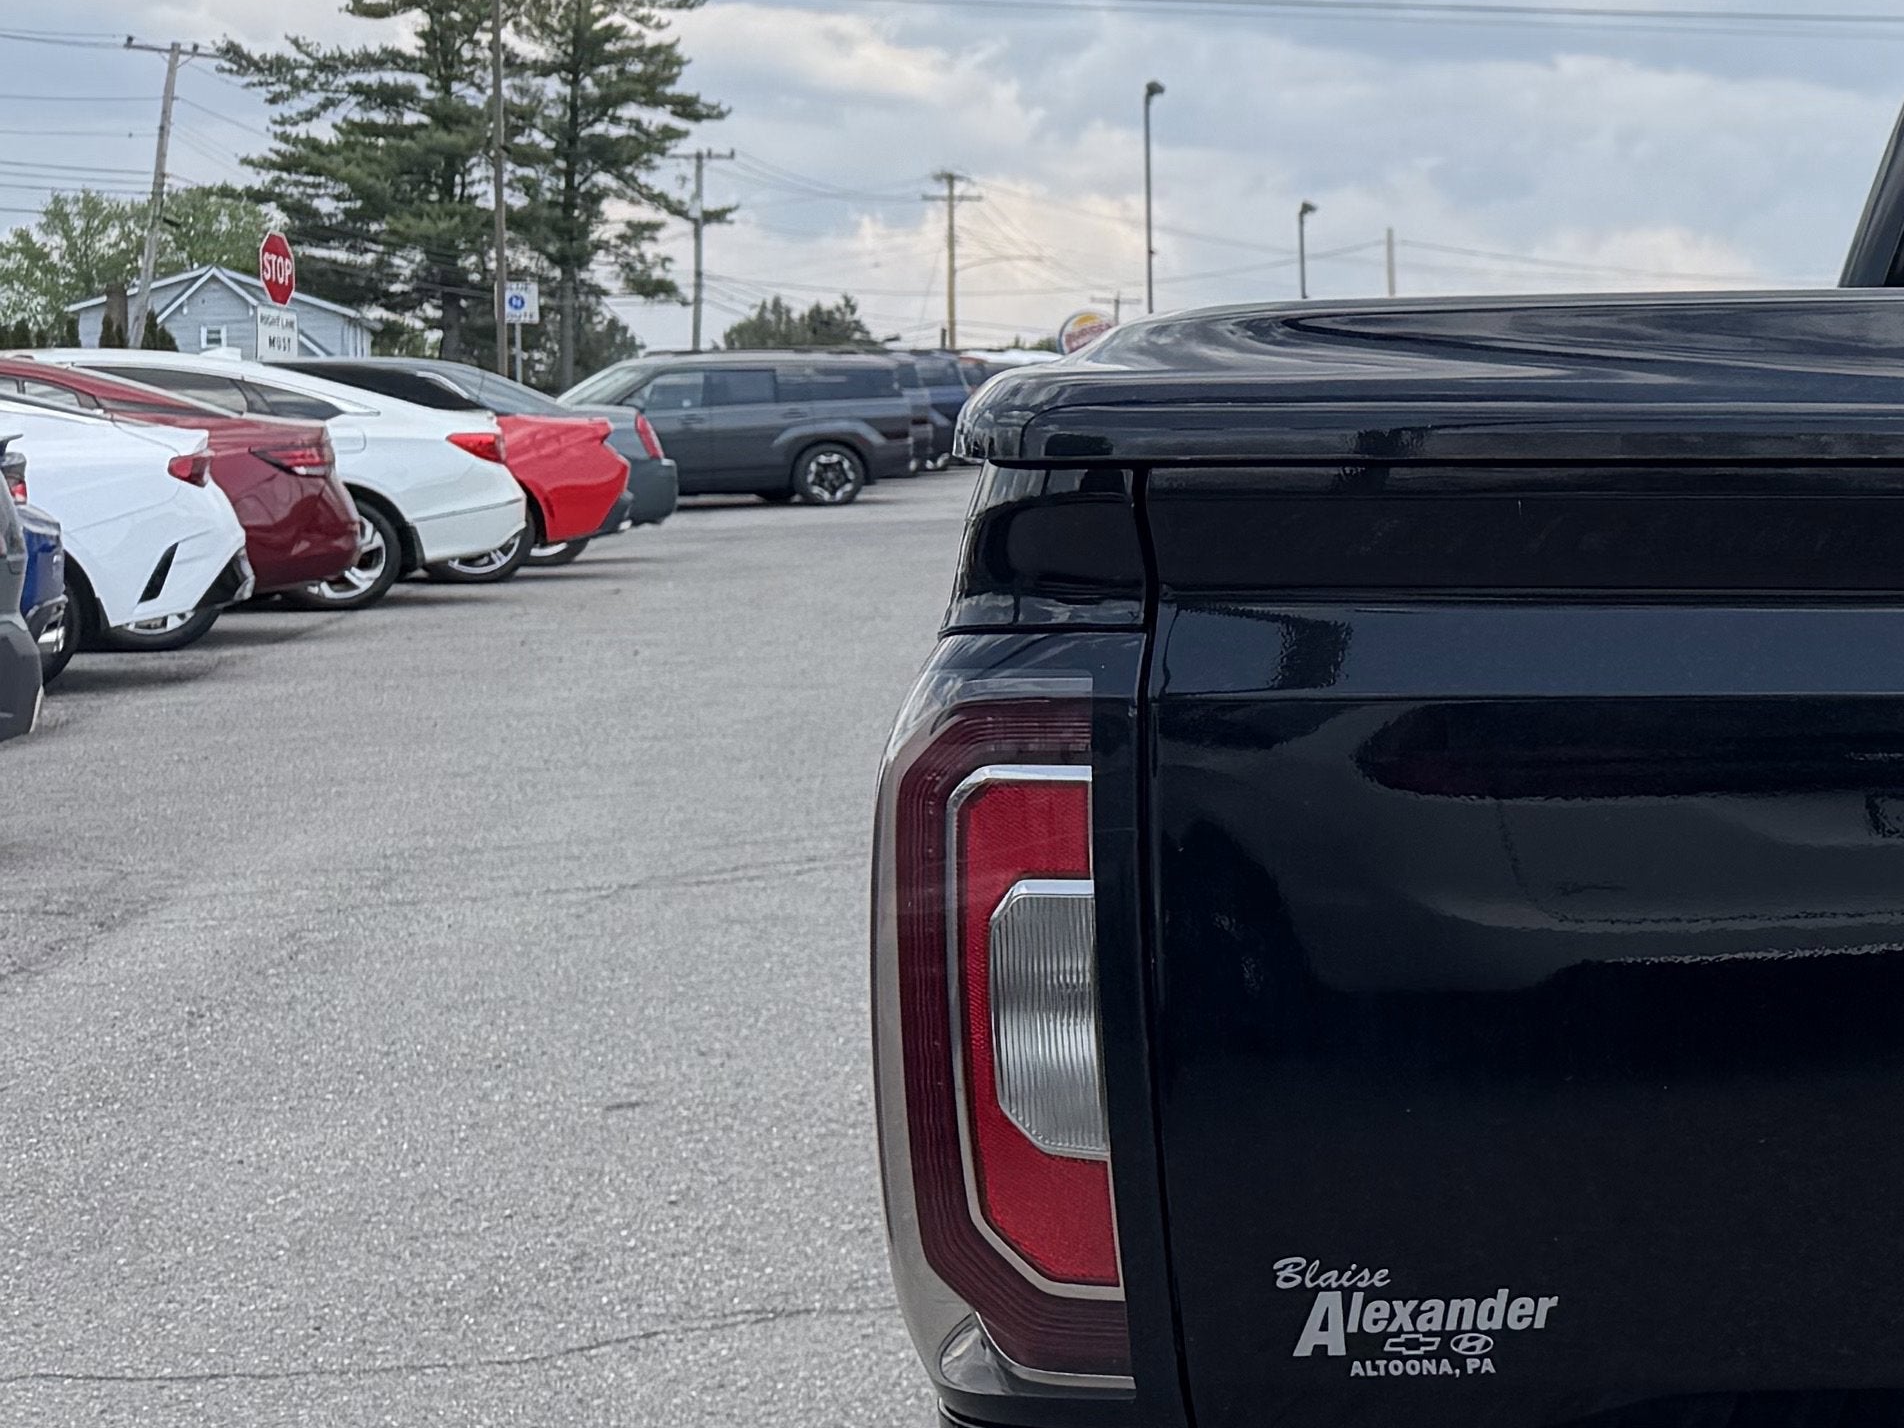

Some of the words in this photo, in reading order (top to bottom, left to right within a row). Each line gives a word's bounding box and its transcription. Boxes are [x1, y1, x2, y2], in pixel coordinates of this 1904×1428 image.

[263, 251, 292, 286] STOP
[1273, 1257, 1391, 1289] Blaise
[1292, 1288, 1559, 1356] Alexander
[1350, 1359, 1460, 1378] ALTOONA,
[1466, 1357, 1496, 1374] PA
